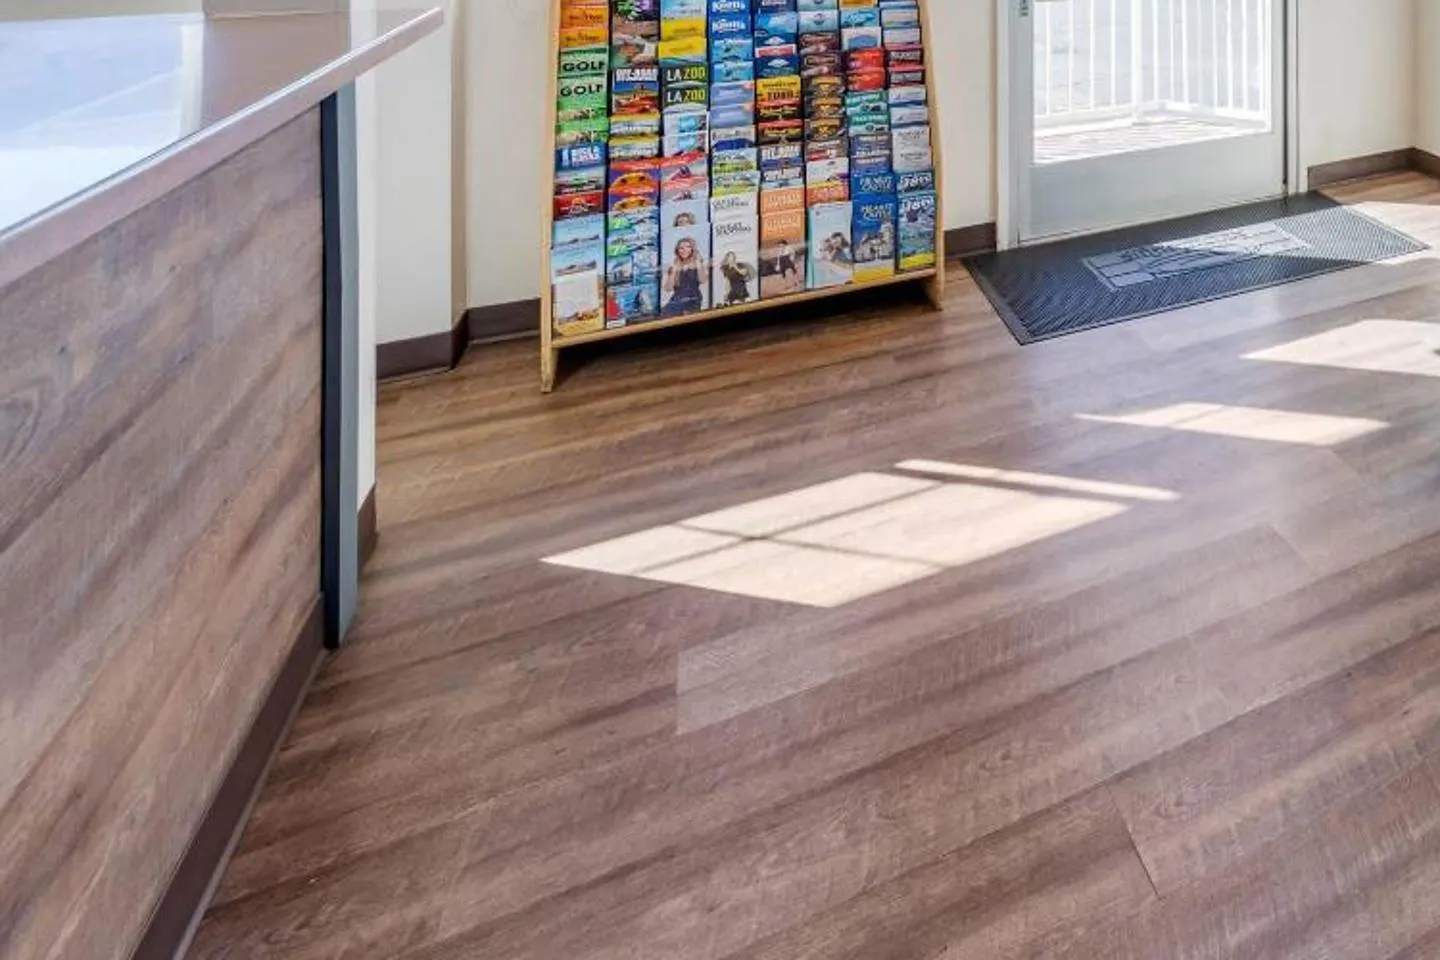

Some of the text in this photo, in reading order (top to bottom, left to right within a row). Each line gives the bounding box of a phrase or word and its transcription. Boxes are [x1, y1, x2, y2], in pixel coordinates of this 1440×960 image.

[562, 60, 605, 71] GOLF
[666, 68, 682, 81] LA
[683, 66, 706, 80] ZOO
[559, 83, 603, 97] GOLF
[666, 88, 706, 103] LA ZOO
